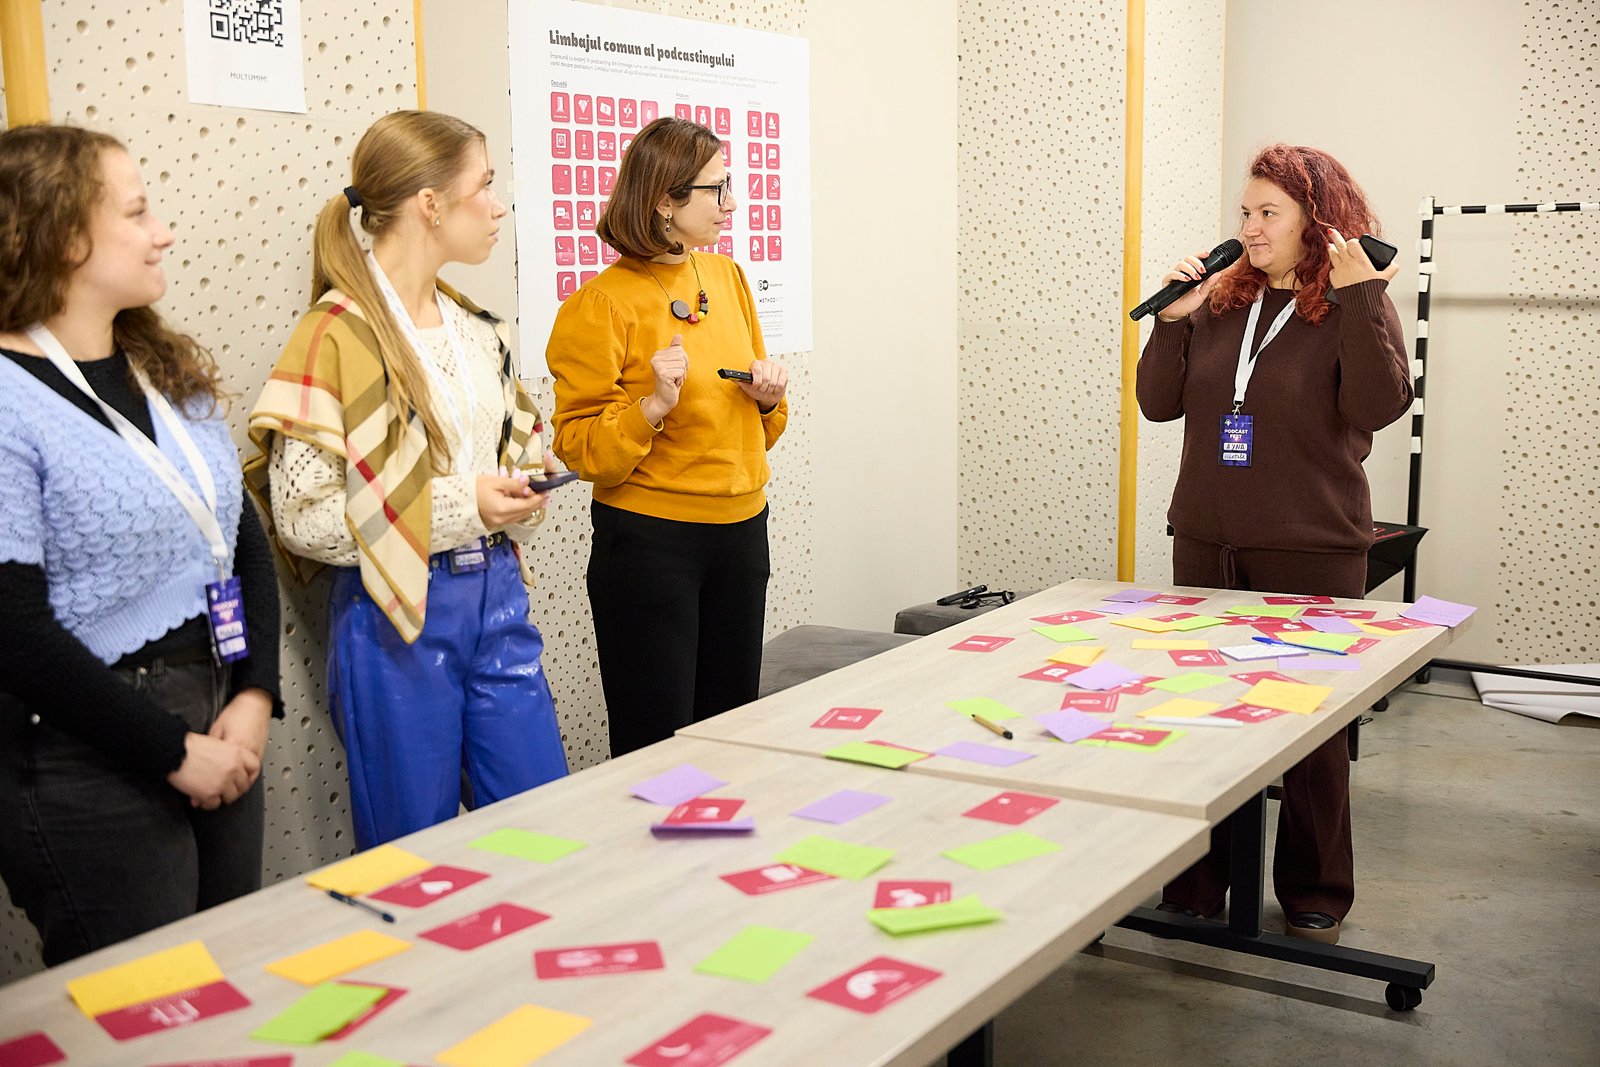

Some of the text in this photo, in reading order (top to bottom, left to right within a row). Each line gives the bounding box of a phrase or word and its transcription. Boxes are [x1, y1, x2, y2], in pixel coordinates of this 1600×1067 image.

[549, 29, 735, 68] Limbajul comun al podcastingului
